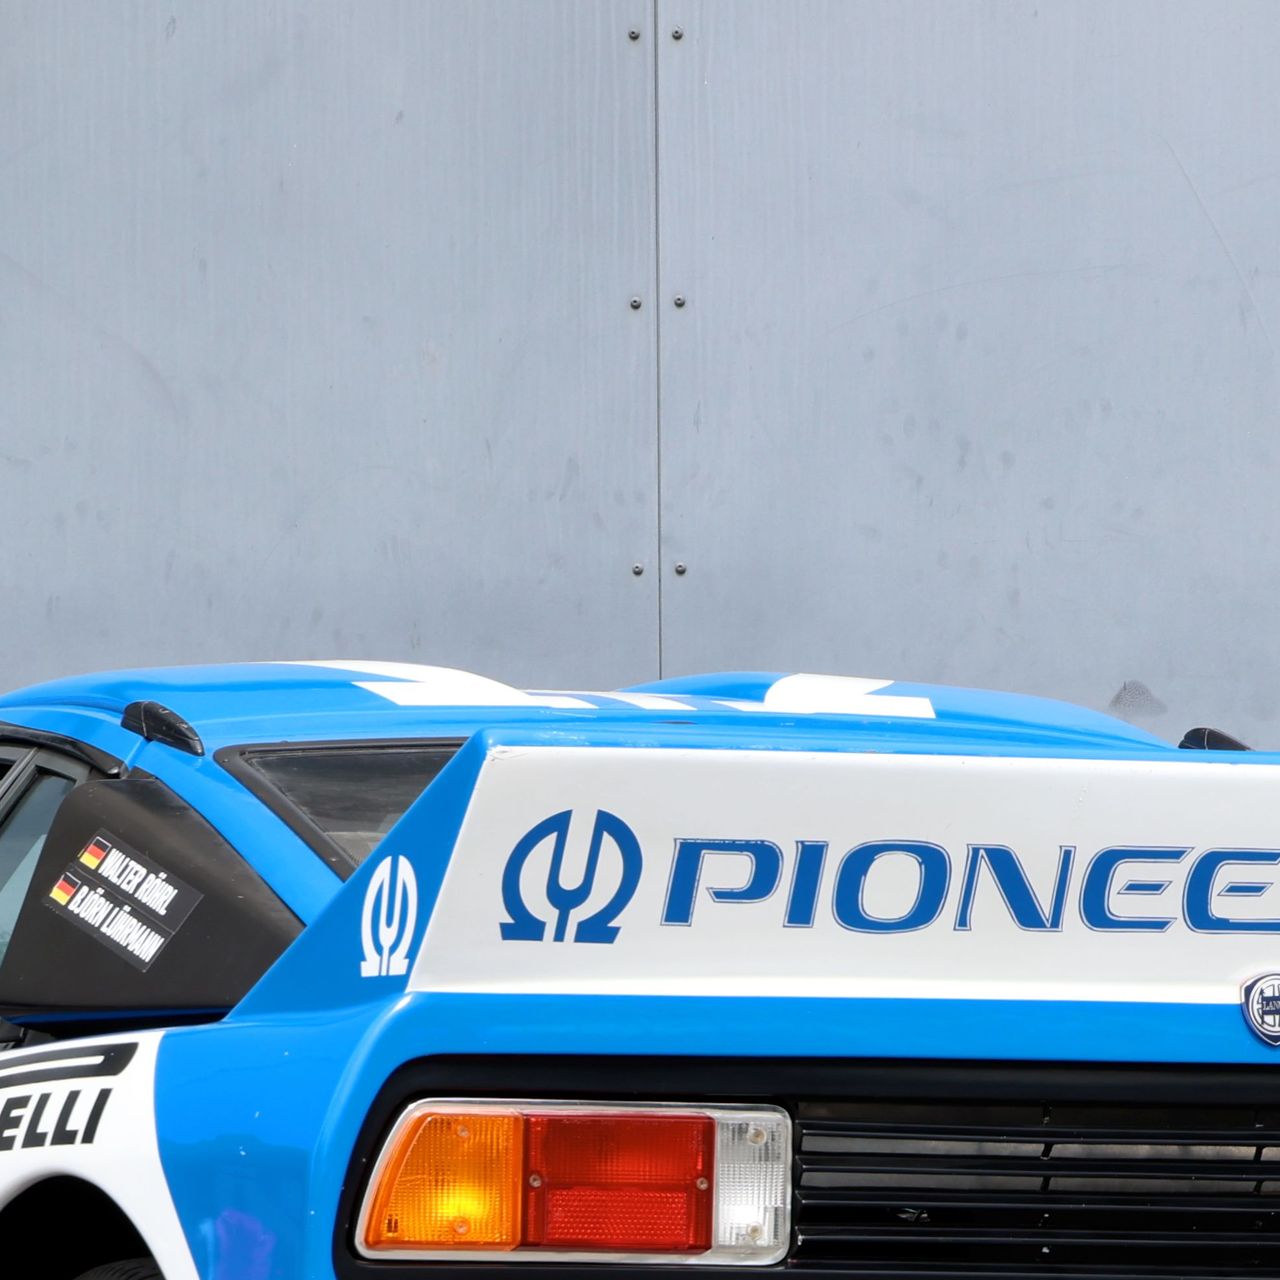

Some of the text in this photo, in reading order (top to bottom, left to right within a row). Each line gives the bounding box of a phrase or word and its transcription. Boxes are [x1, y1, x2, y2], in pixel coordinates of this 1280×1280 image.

[97, 848, 179, 916] WALTER RÖHRL
[67, 885, 165, 963] BJÖRN LÜHRMANN
